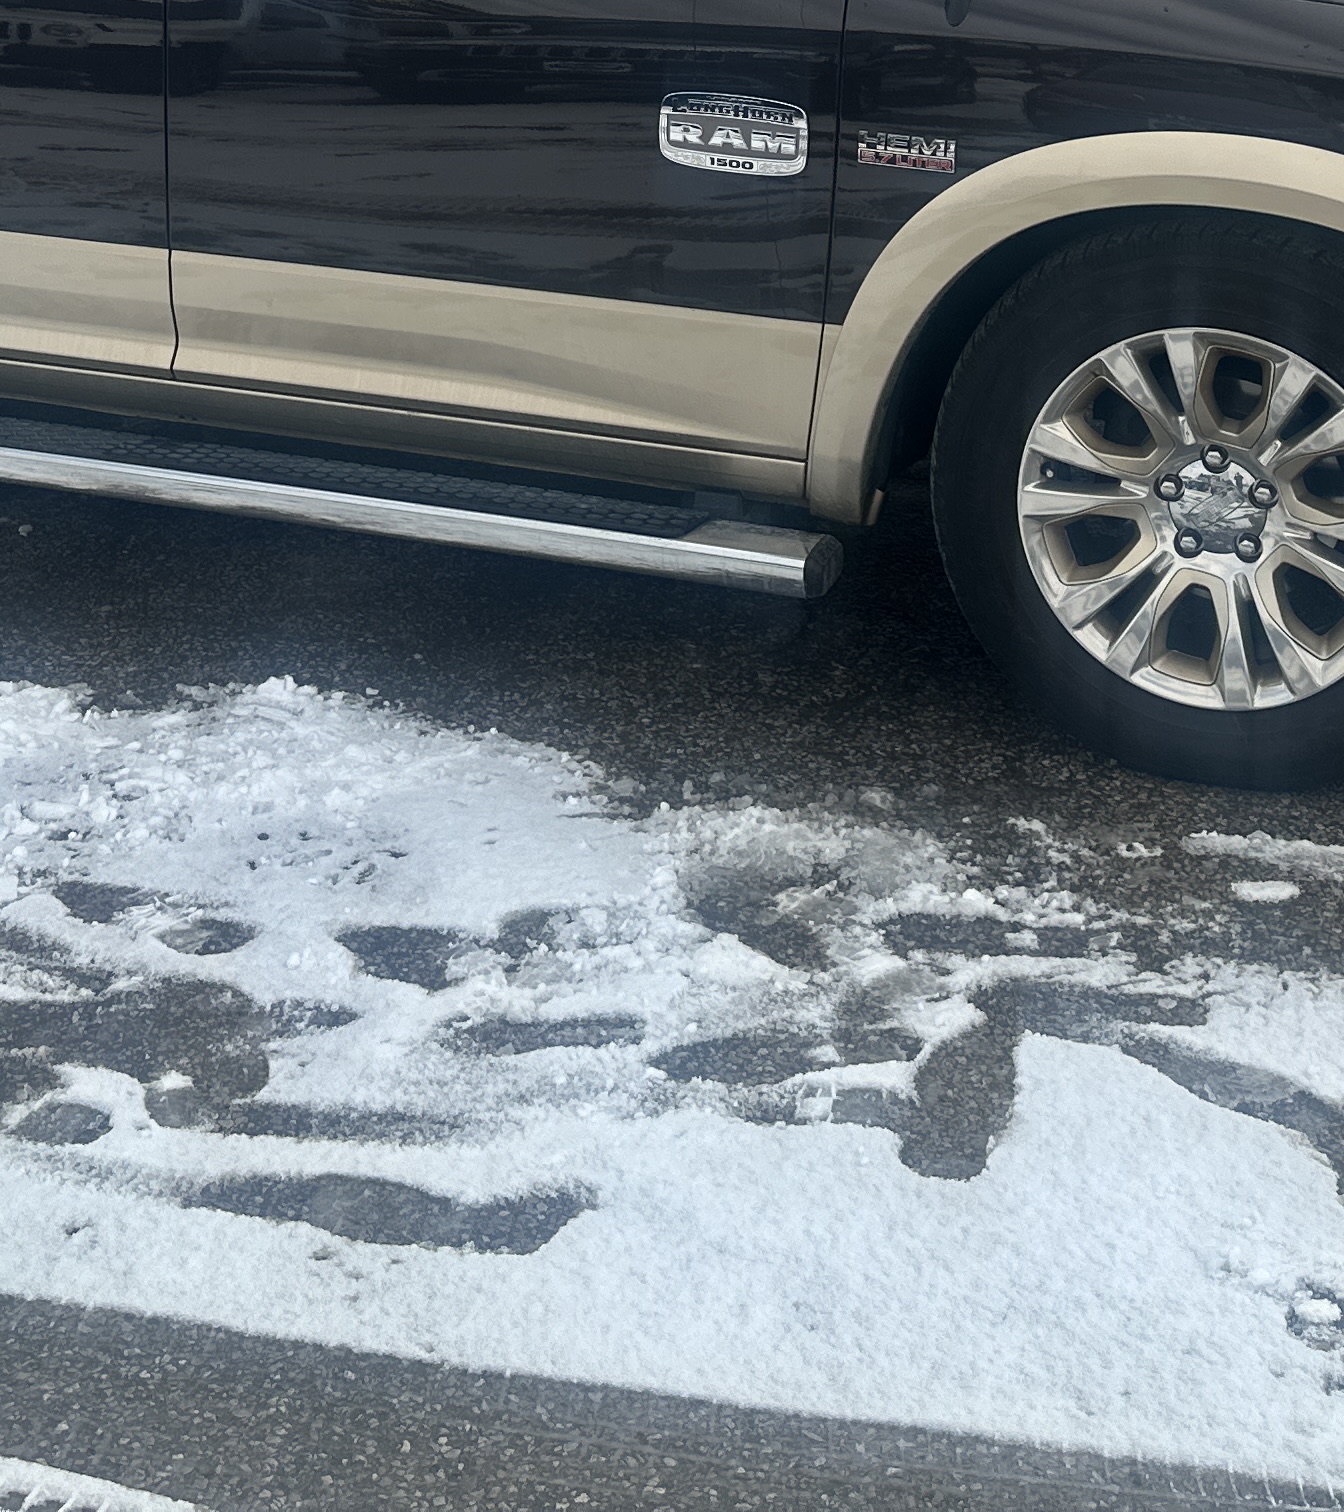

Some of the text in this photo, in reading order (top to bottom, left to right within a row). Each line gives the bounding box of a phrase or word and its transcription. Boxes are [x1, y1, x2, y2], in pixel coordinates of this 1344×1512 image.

[669, 120, 797, 156] RAM
[857, 130, 956, 159] HEMI
[709, 156, 754, 170] 1500
[895, 154, 953, 172] LITER
